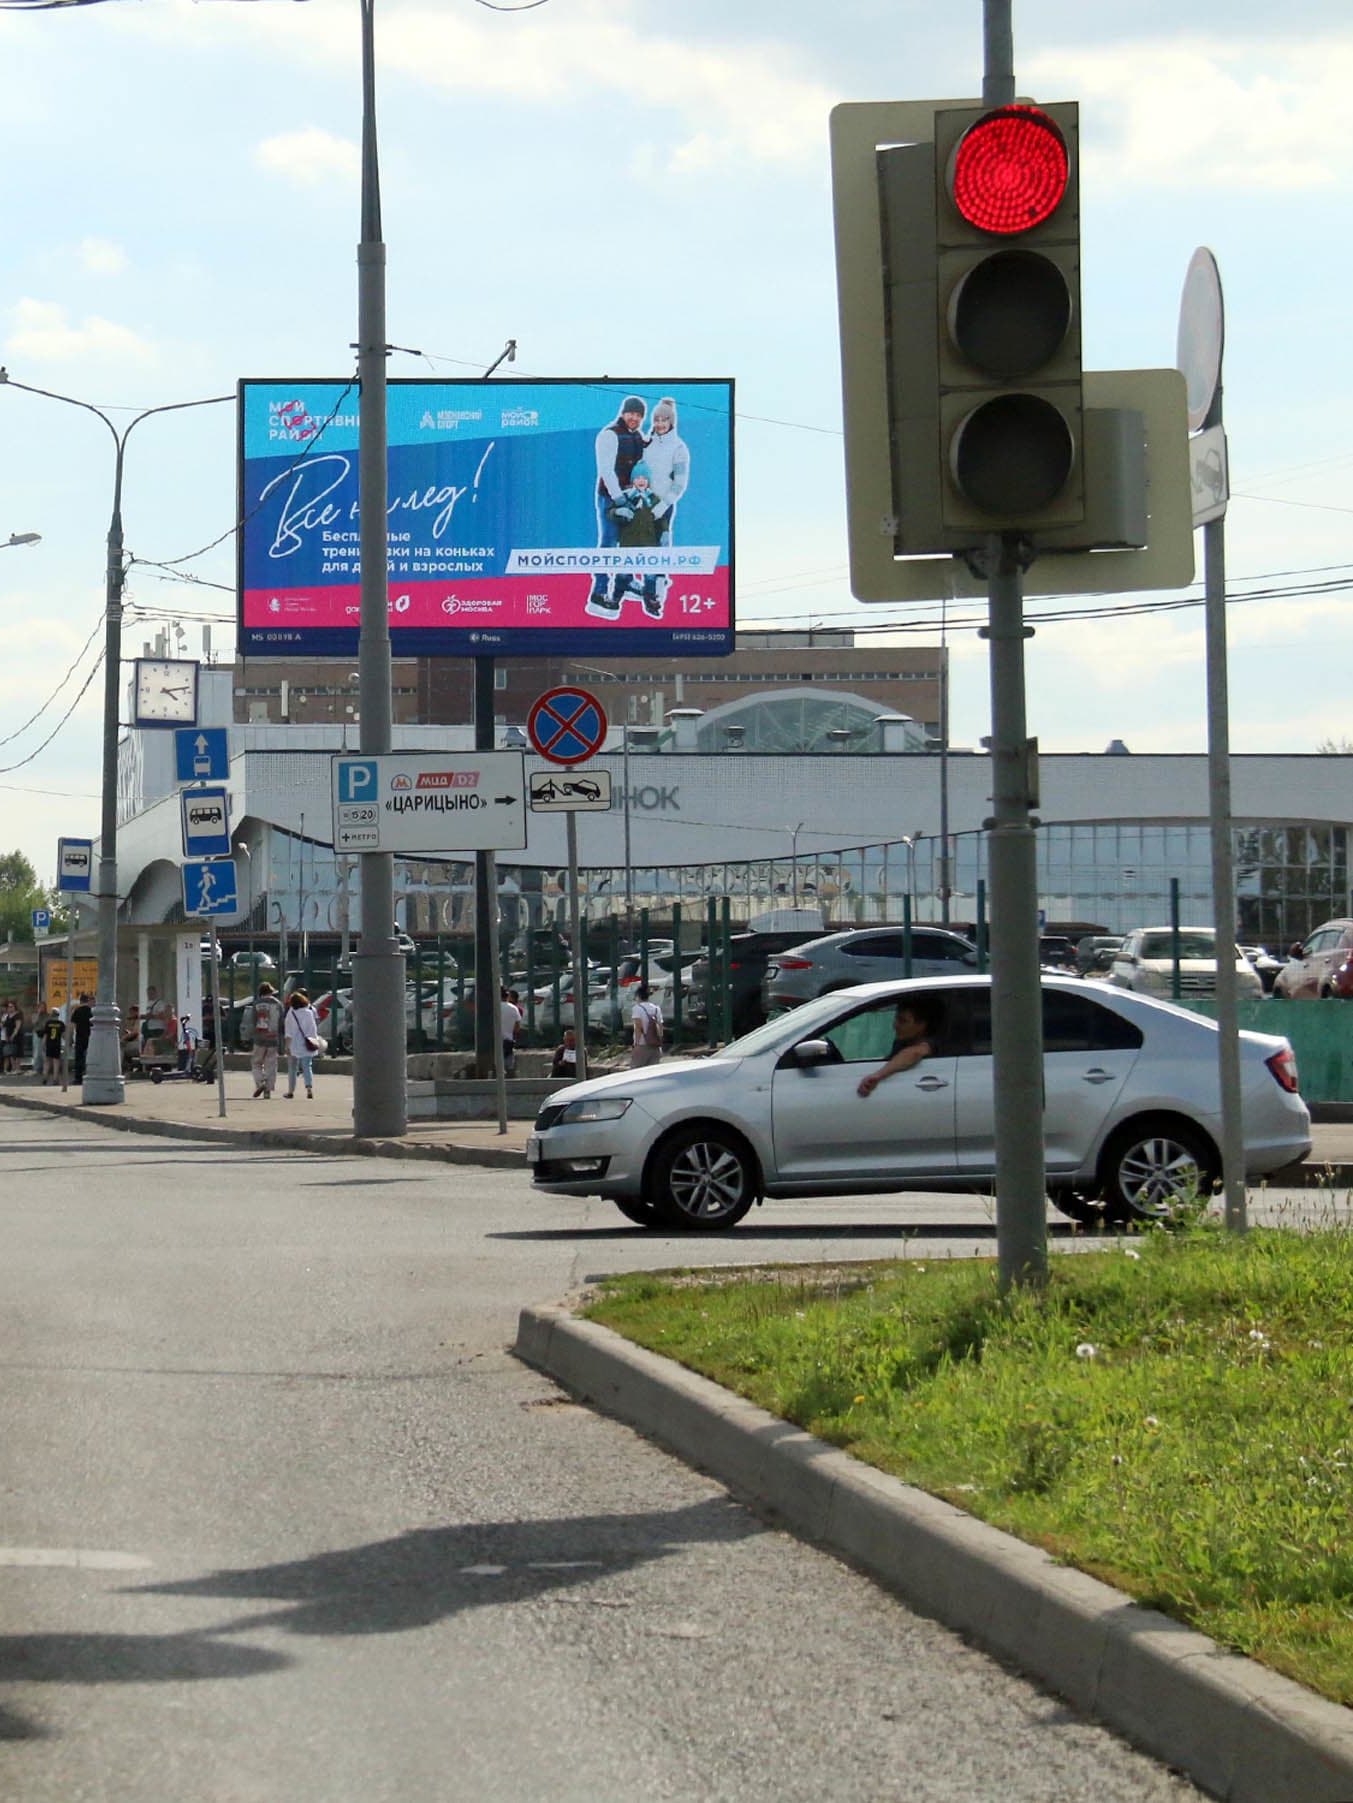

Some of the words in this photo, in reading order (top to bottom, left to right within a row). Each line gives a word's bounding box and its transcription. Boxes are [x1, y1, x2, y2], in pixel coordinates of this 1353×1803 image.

[269, 400, 305, 412] МОЙ
[269, 415, 360, 426] СПОРТИВН
[269, 428, 323, 440] РАЙОН
[414, 547, 431, 557] на
[435, 547, 495, 557] коньках
[517, 553, 702, 567] МОЙСПОРТРАЙОН.РФ
[322, 561, 348, 573] для
[400, 562, 409, 571] и
[412, 561, 483, 573] взрослых
[529, 594, 549, 602] МОС
[679, 594, 716, 613] 12+
[349, 765, 370, 799] P
[385, 794, 488, 815] «ЦАРИЦЫНО»
[351, 833, 377, 841] МЕТРО
[36, 911, 47, 925] P
